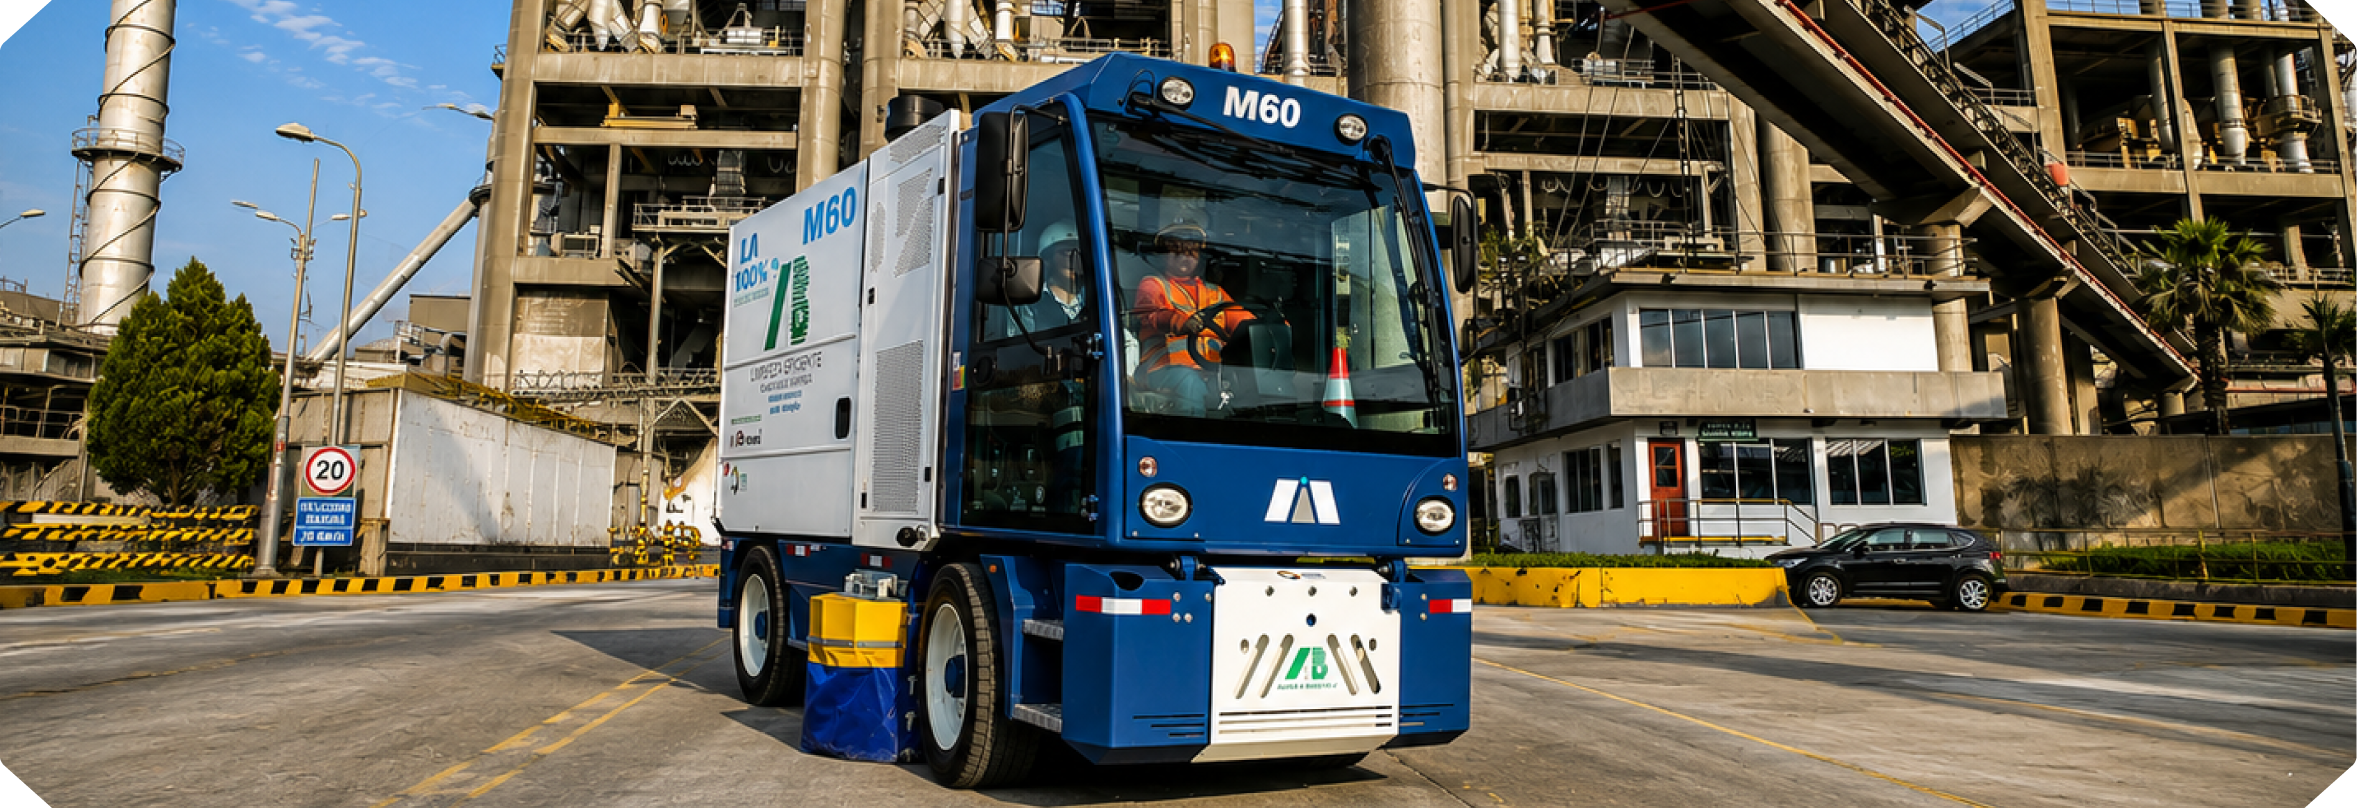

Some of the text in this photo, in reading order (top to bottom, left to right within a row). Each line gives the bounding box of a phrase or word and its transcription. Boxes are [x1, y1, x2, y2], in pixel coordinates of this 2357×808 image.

[1223, 86, 1301, 128] M60
[802, 187, 857, 245] M60
[315, 460, 345, 480] 20
